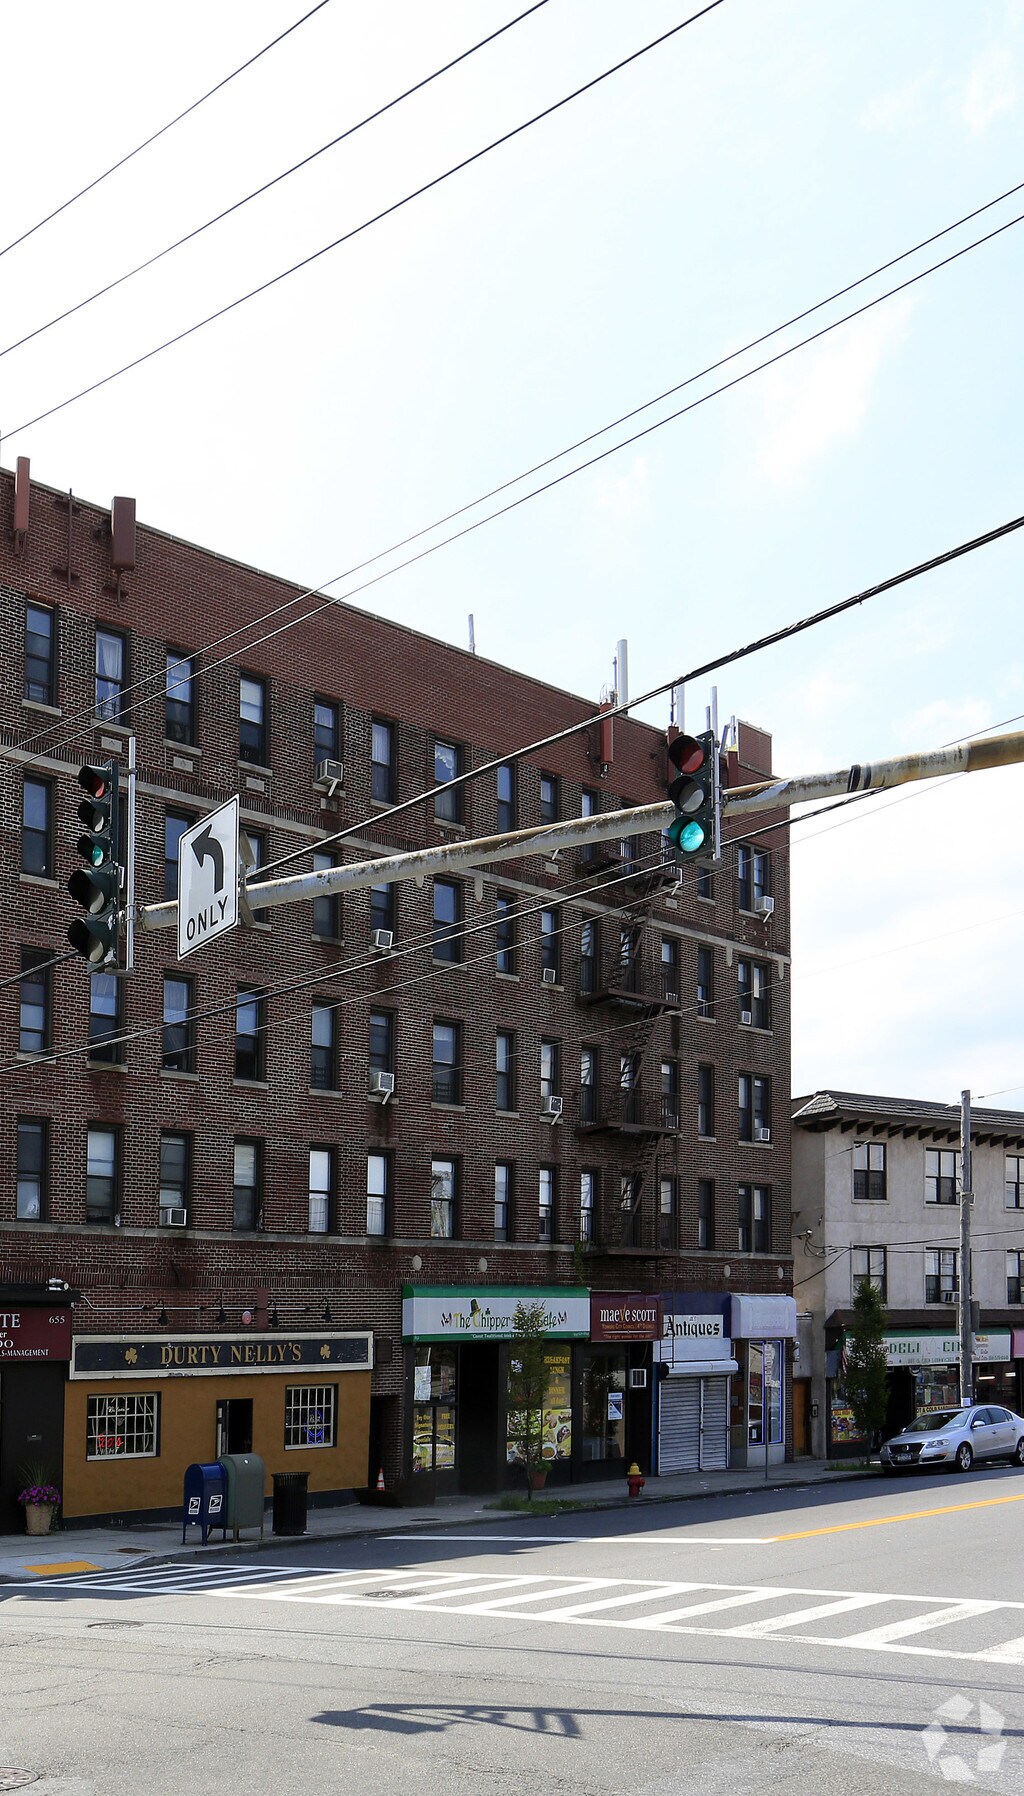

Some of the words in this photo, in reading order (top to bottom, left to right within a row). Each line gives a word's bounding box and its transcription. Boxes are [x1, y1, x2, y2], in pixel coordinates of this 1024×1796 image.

[187, 895, 228, 941] ONLY
[49, 1315, 65, 1324] 655
[453, 1312, 471, 1329] The
[472, 1310, 511, 1330] Chipper
[600, 1304, 631, 1322] maeve
[663, 1315, 720, 1338] Antiques
[160, 1345, 221, 1365] DURTY
[230, 1342, 302, 1363] NELLY'S
[889, 1343, 920, 1354] DELI
